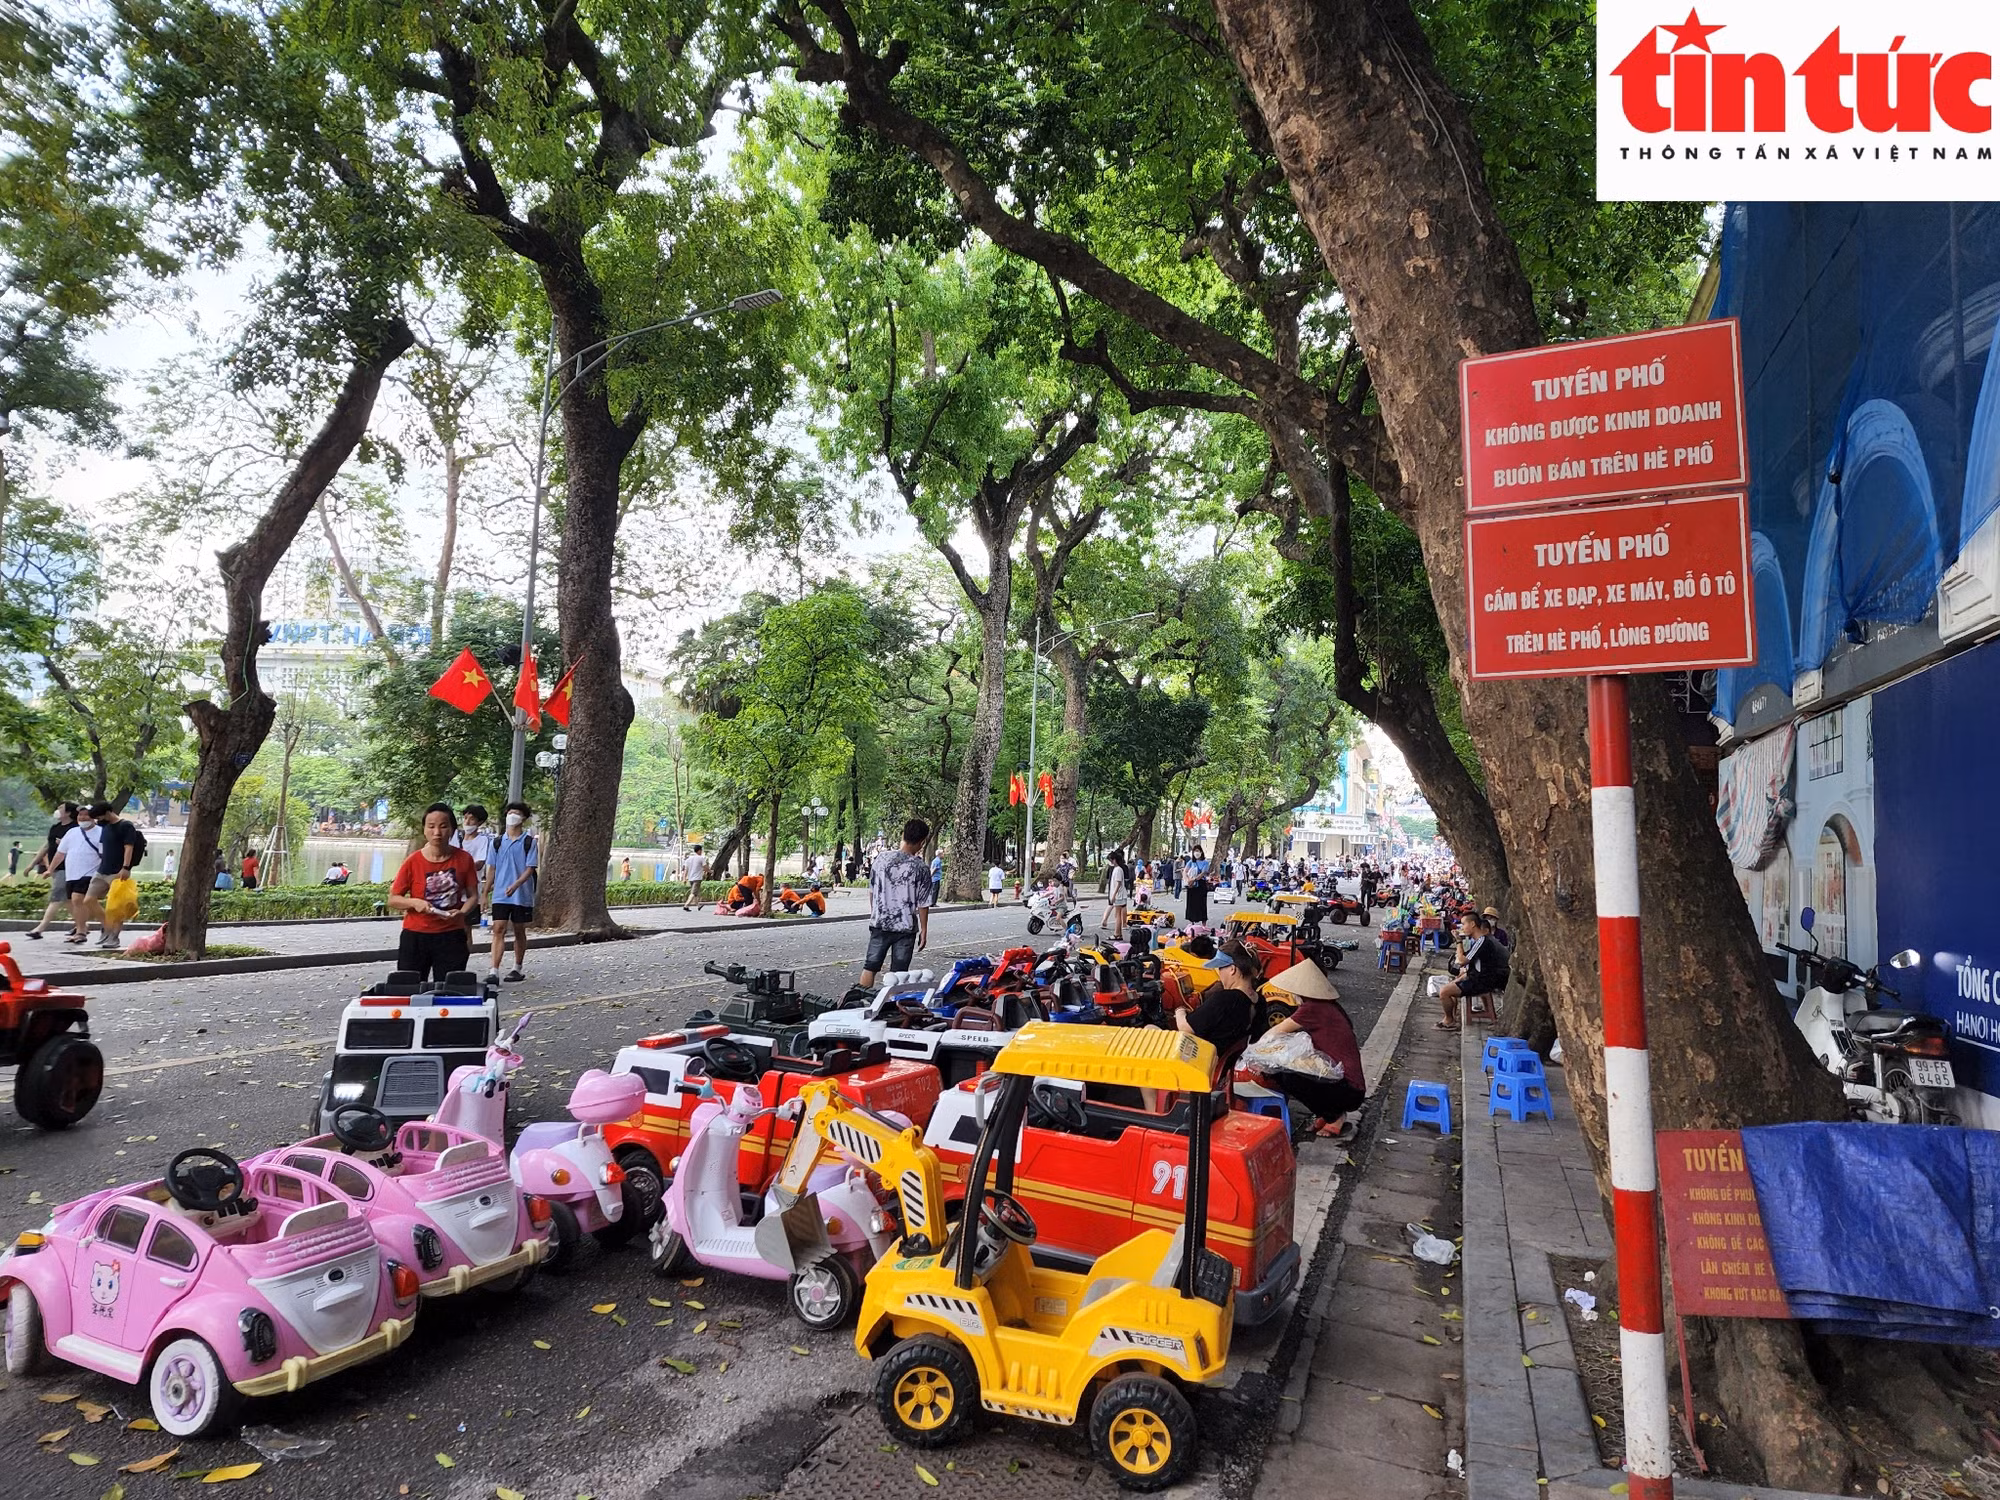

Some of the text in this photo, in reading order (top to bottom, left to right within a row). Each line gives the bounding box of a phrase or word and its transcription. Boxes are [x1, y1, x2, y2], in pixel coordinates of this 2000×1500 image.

[1531, 354, 1667, 402] TUYẾN PHỐ
[1485, 401, 1722, 447] KHÔNG ĐƯỢC KINH DOANH
[1493, 461, 1542, 488] BUÔN
[1548, 456, 1586, 481] BÁN
[1591, 451, 1638, 475] TRÊN
[1674, 440, 1714, 467] PHỐ
[1534, 522, 1672, 567] TUYẾN PHỐ
[1484, 569, 1736, 612] CẤM ĐỂ XE ĐẠP, XE MÁY, ĐỖ Ô TÔ
[1506, 630, 1544, 654] TRÊN
[1547, 627, 1567, 651] HÈ
[1609, 623, 1650, 648] LÒNG
[1654, 617, 1710, 644] ĐƯỜNG
[1955, 954, 1990, 1003] TỔNG
[961, 1034, 989, 1043] SPEED
[1956, 1010, 2000, 1044] HANOI H
[1915, 1060, 1948, 1074] 99-F5
[1918, 1072, 1950, 1086] 8485
[1682, 1139, 1744, 1172] TUYẾN
[1151, 1160, 1187, 1200] 91
[1689, 1184, 1719, 1200] KHÔNG
[1692, 1209, 1722, 1225] KHÔNG
[1724, 1213, 1746, 1226] KINH
[1696, 1234, 1727, 1250] KHÔNG
[1133, 1333, 1183, 1350] DIGGER
